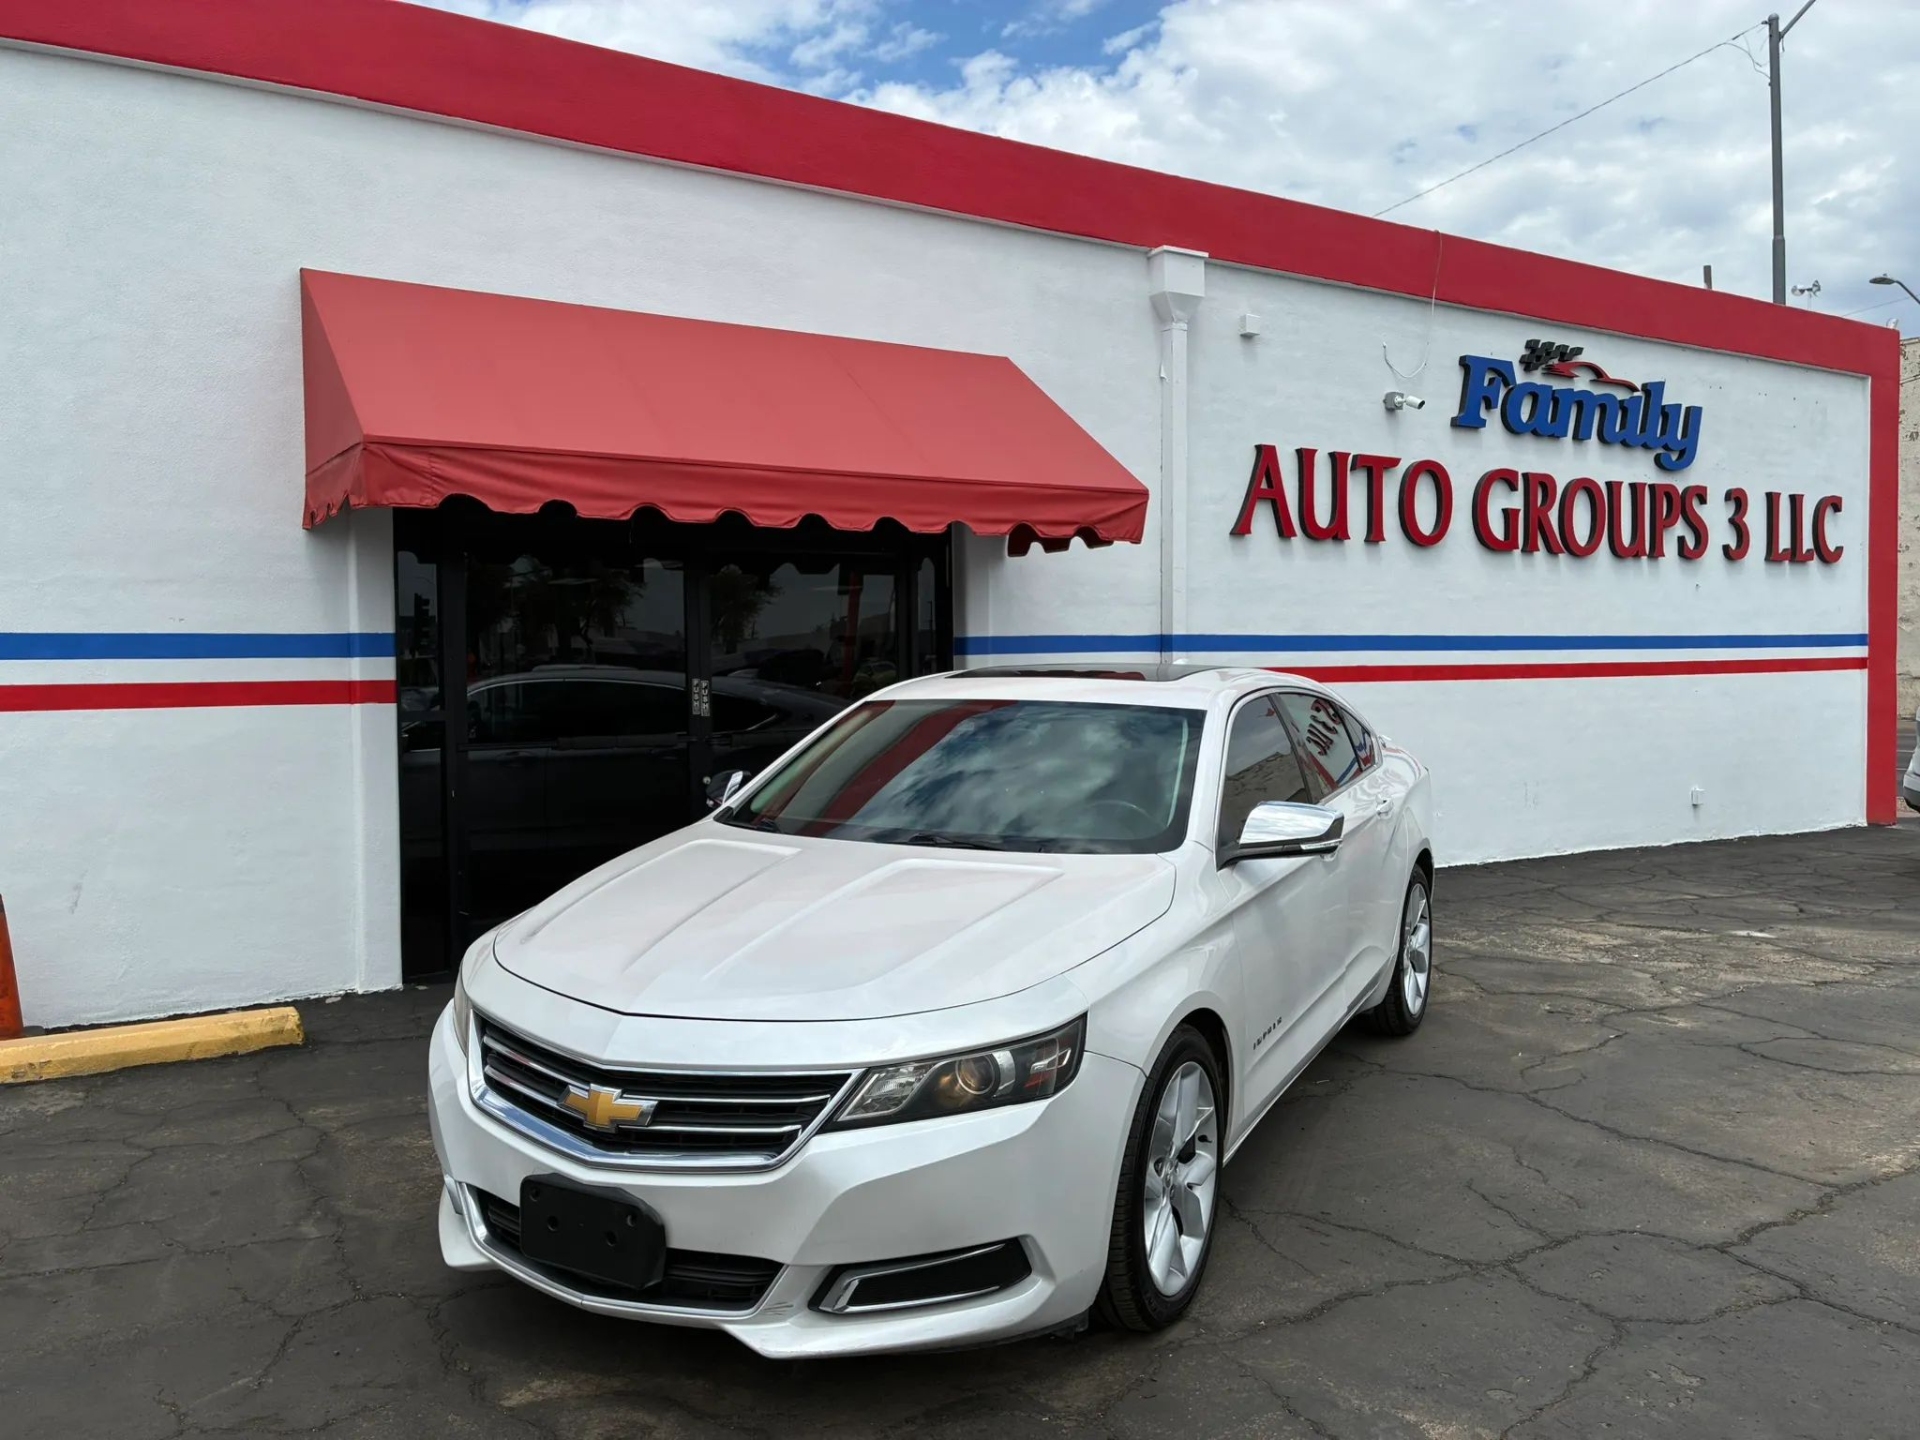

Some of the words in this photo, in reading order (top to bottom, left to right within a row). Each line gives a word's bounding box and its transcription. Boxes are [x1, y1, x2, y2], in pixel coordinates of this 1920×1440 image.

[1450, 354, 1703, 472] Family
[1229, 443, 1453, 547] AUTO
[1471, 467, 1709, 561] GROUPS
[1722, 488, 1750, 561] 3
[1765, 491, 1844, 564] LLC
